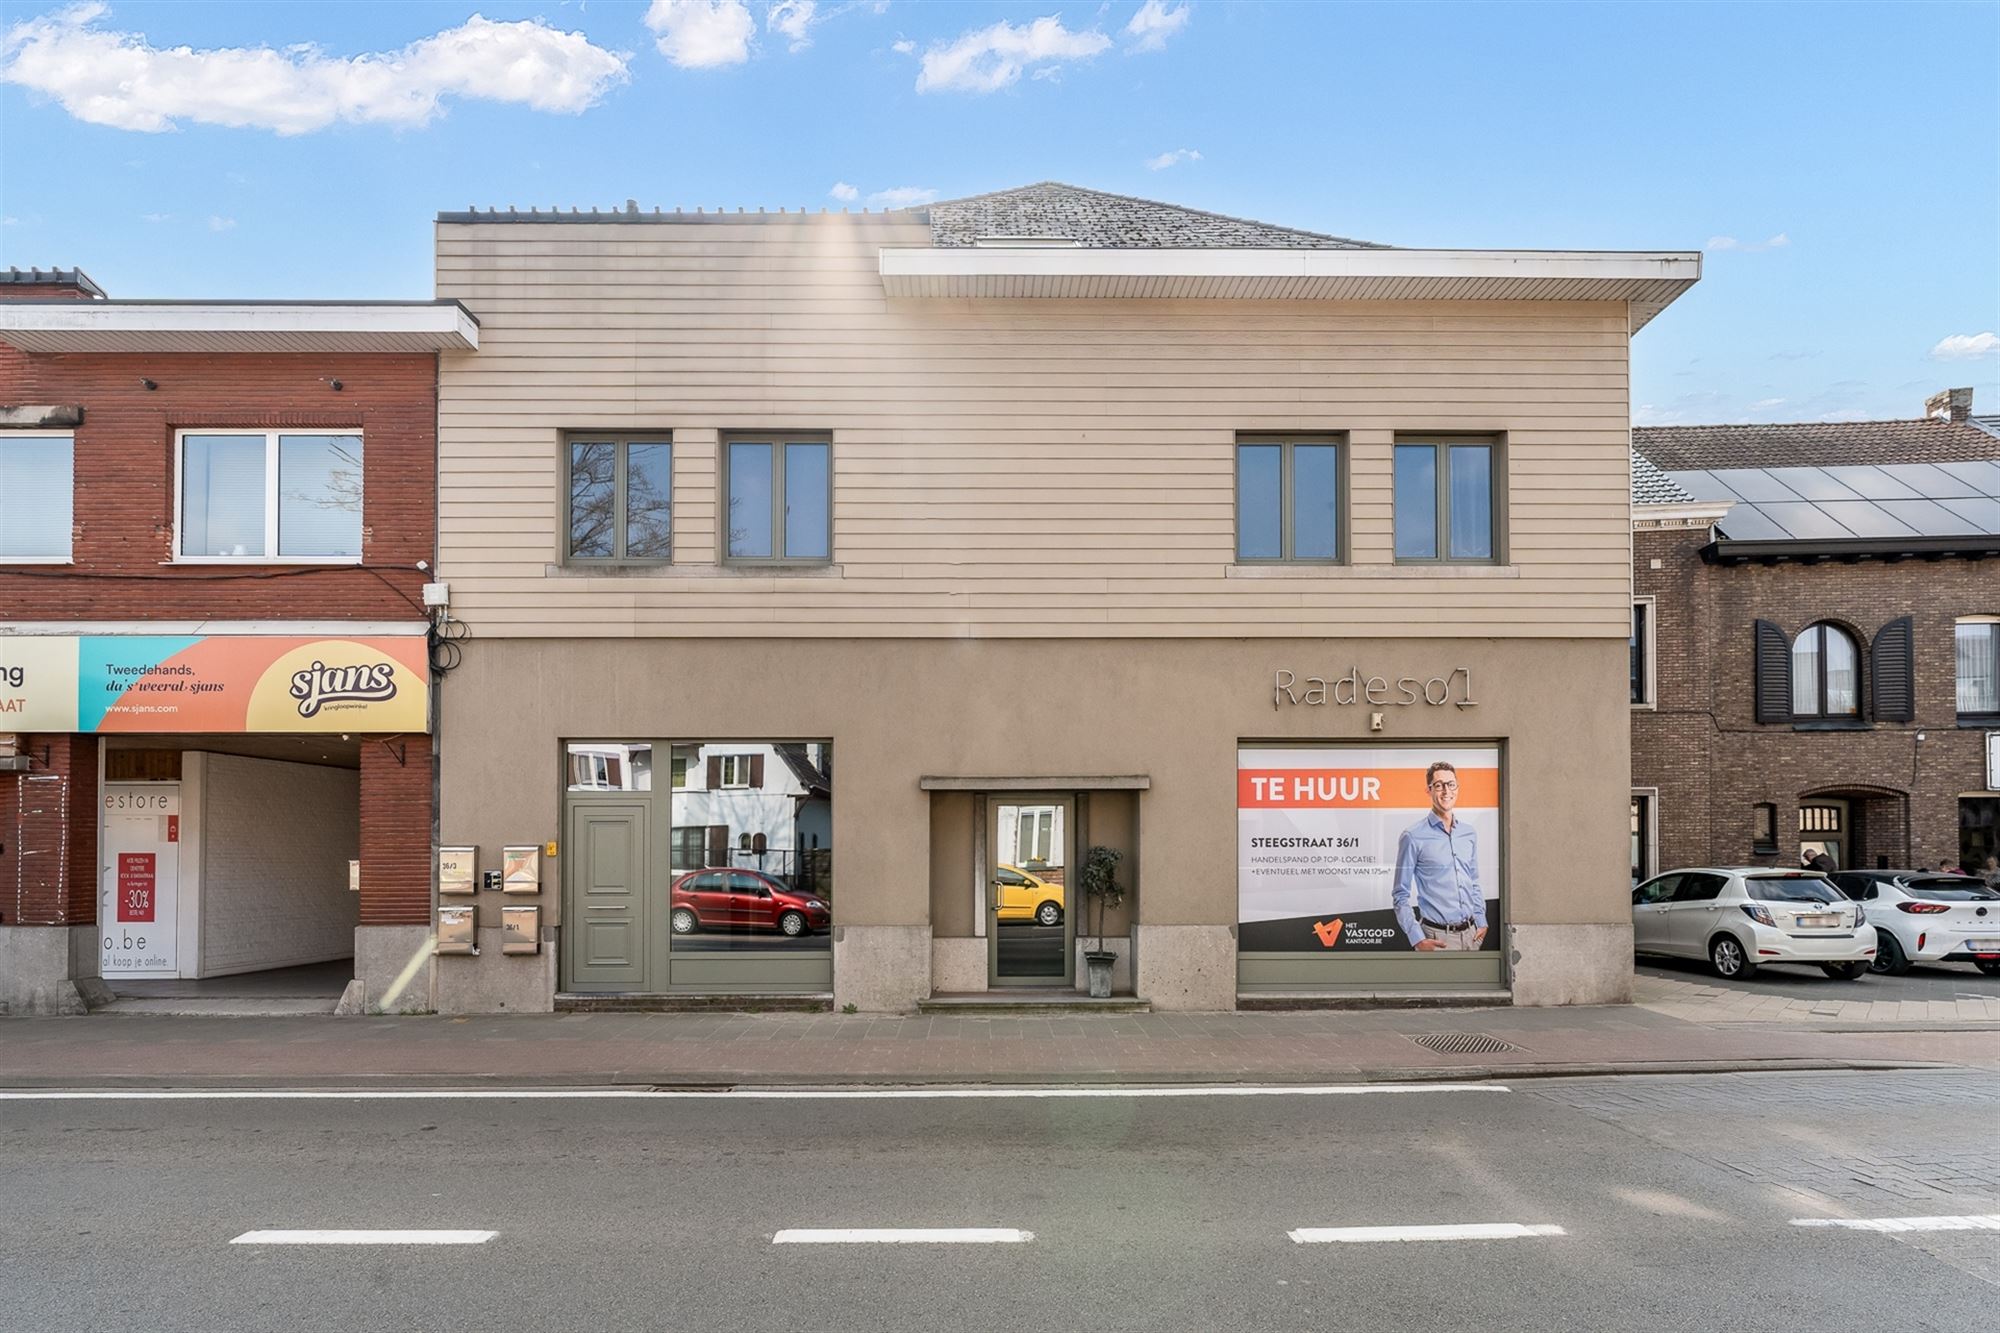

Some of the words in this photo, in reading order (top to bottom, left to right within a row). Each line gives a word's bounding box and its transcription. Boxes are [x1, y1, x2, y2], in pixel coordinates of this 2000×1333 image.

[105, 663, 196, 676] Tweedehands,
[189, 680, 224, 694] sjans
[290, 660, 397, 718] sjans
[105, 705, 178, 714] www.sjans.com
[1251, 777, 1285, 801] TE
[1294, 777, 1381, 801] HUUR
[105, 792, 168, 809] estore
[1251, 837, 1334, 848] STEEGSTRAAT
[1336, 837, 1359, 848] 36/1
[125, 889, 149, 909] -30%
[103, 928, 146, 950] o.be
[1345, 929, 1395, 938] VASTGOED
[113, 954, 132, 968] koop
[134, 956, 142, 968] je
